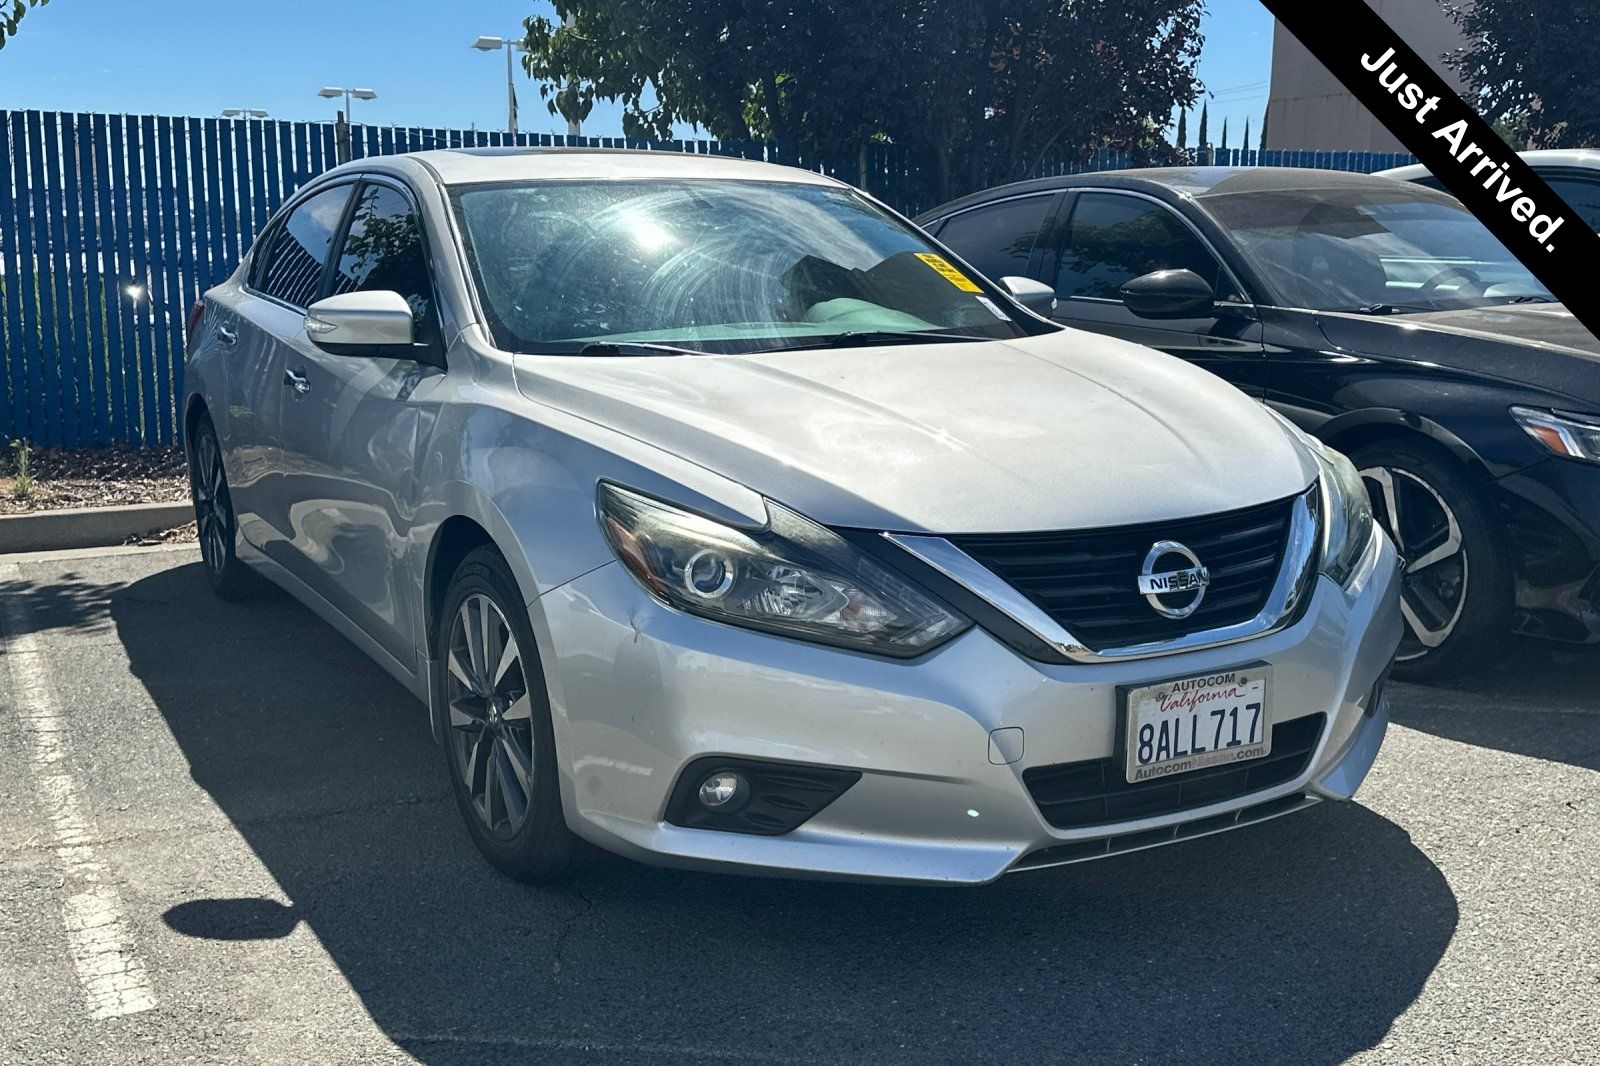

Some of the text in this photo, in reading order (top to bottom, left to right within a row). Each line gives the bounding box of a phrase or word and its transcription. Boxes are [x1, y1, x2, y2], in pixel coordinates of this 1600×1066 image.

[1149, 568, 1208, 590] NISSAN
[1172, 673, 1235, 693] AUTOCOM
[1159, 687, 1246, 713] California
[1138, 702, 1261, 765] 8ALL717
